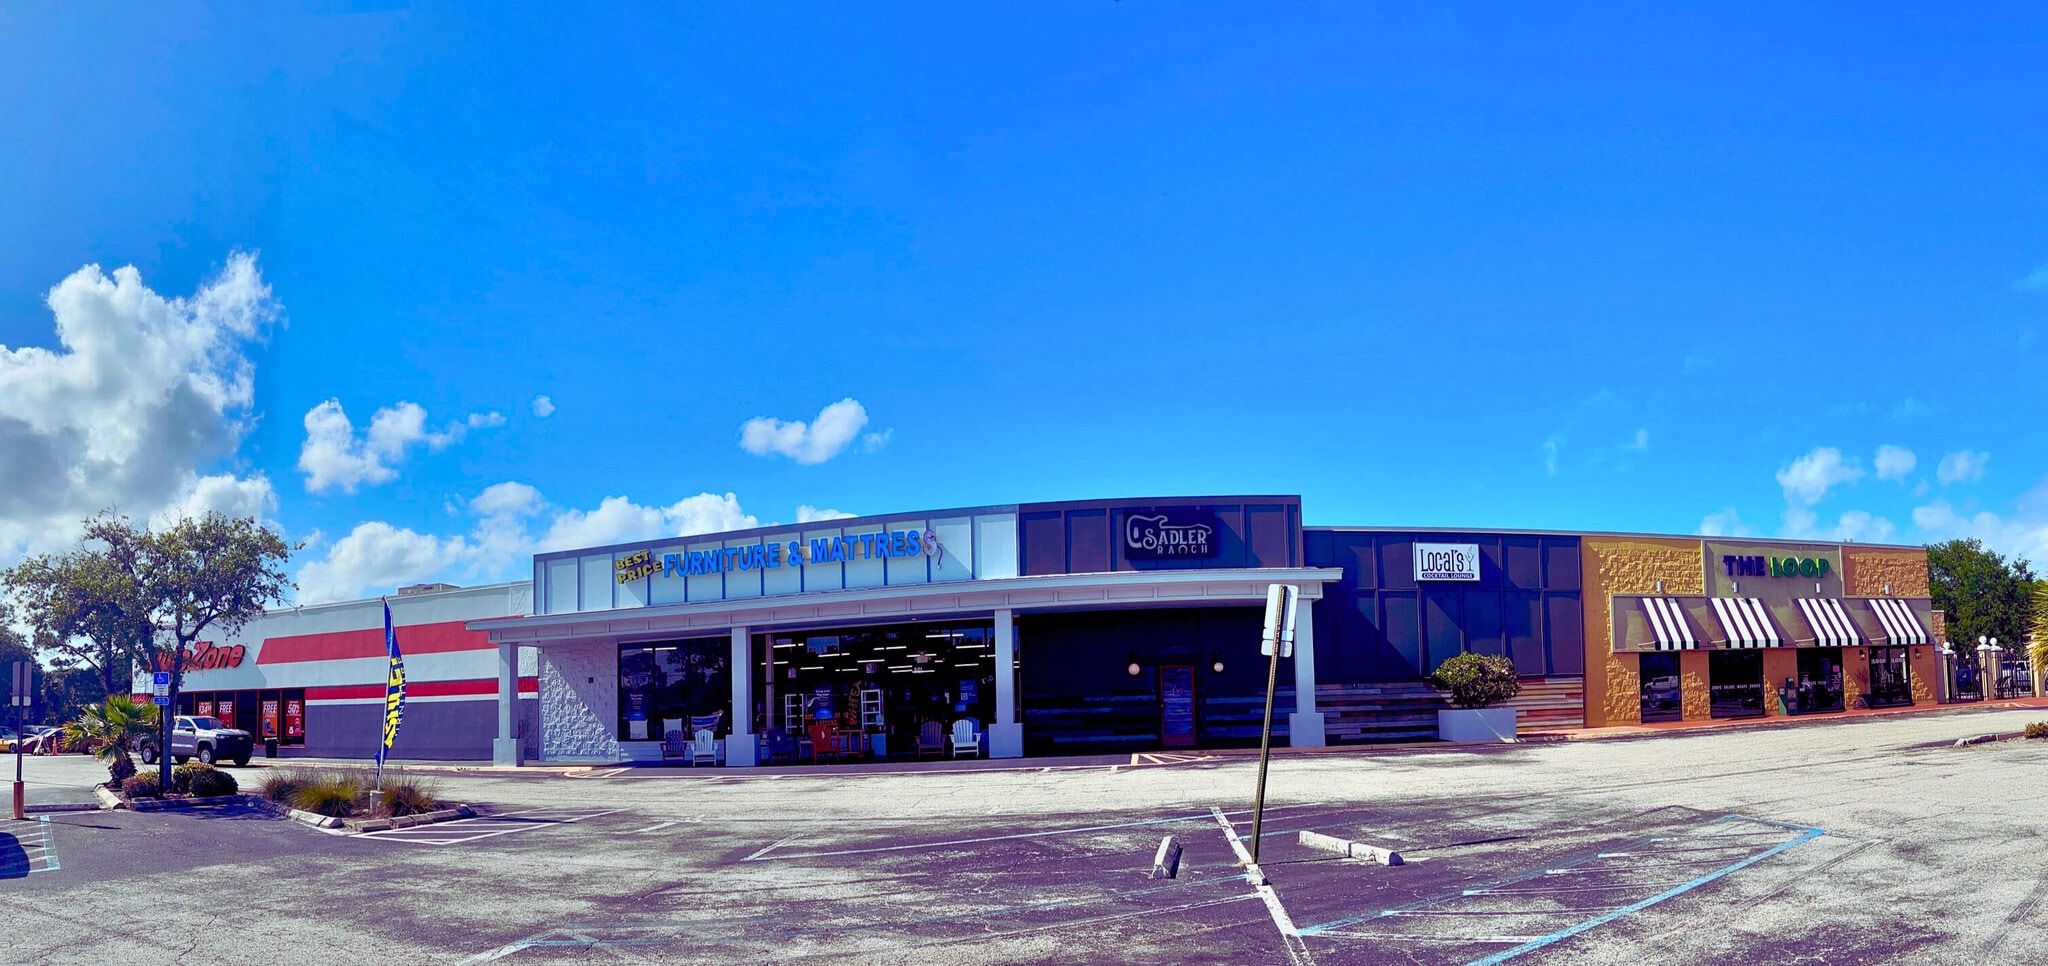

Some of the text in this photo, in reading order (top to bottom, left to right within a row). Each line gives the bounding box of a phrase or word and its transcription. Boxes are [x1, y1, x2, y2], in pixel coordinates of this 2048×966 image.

[1143, 528, 1207, 549] SADLER
[614, 550, 652, 571] BEST
[664, 529, 937, 579] FURNITURE & MATTRESS
[616, 561, 663, 585] PRICE
[1723, 555, 1830, 578] THE LOOP
[219, 704, 233, 714] FREE
[263, 704, 277, 715] FREE
